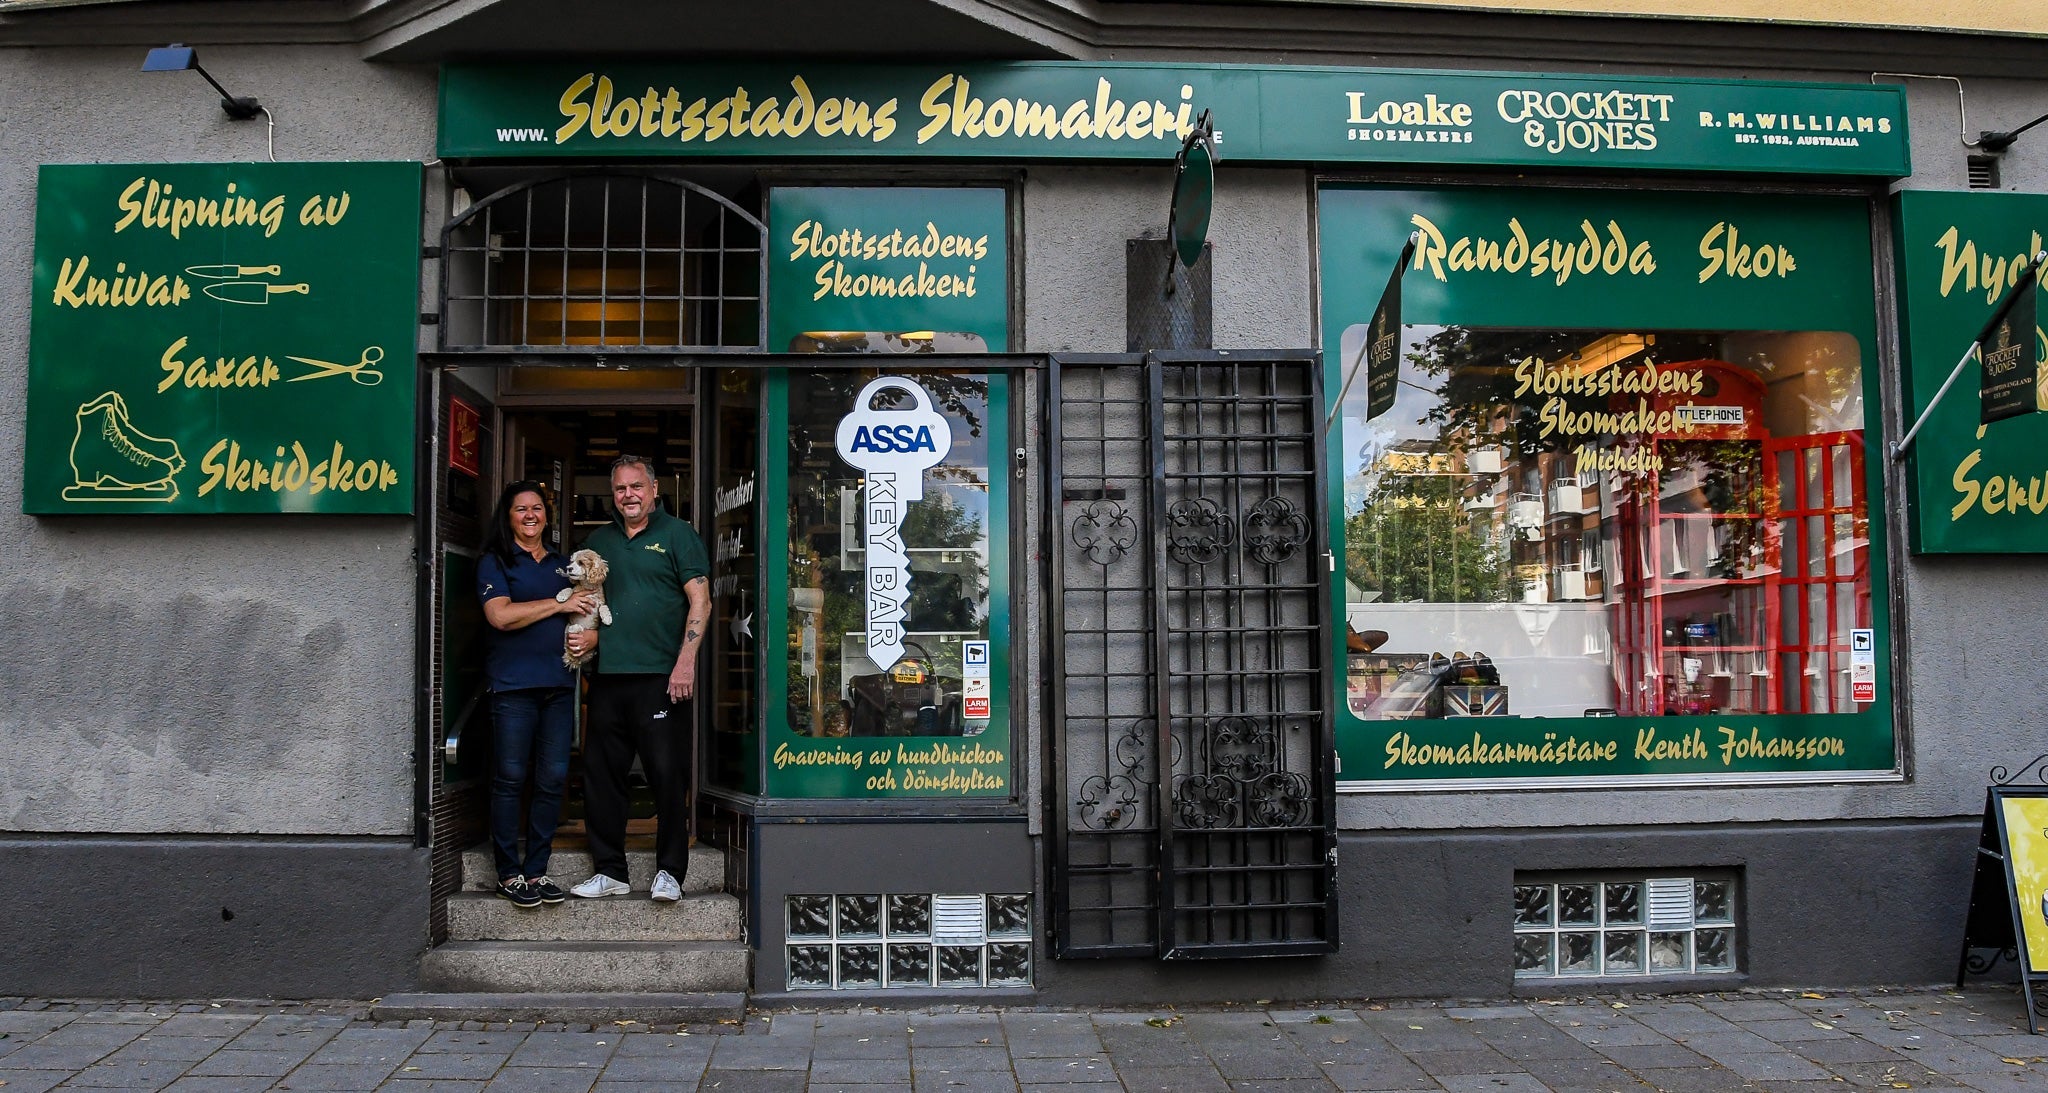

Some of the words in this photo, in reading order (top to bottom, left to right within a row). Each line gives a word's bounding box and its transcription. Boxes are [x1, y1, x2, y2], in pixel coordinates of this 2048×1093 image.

[496, 128, 549, 142] www.
[555, 73, 897, 144] Slottsstadens
[917, 73, 1195, 145] Skomakeri
[1345, 91, 1473, 127] Loake
[1497, 89, 1674, 124] CROCKETT
[1347, 128, 1473, 143] SHOEMAKERS
[1735, 133, 1759, 144] EST.
[1796, 135, 1859, 147] AUSTRALIA
[114, 176, 285, 239] Slipning
[299, 190, 350, 227] av
[790, 219, 988, 262] Slottsstadens
[1411, 214, 1657, 287] Randsydda
[1698, 221, 1797, 284] Skor
[53, 256, 191, 309] Knivar
[813, 261, 977, 302] Skomakeri
[157, 336, 281, 394] Saxar
[1514, 356, 1704, 400] Slottsstadens
[1985, 345, 2021, 367] CROCKETT
[1539, 396, 1695, 440] Skomakeri
[197, 438, 399, 498] Skridskor
[1573, 444, 1664, 475] Michelin
[868, 472, 897, 554] KEY
[869, 566, 898, 648] BAR
[773, 742, 863, 769] Gravering
[868, 749, 892, 766] av
[897, 742, 1004, 766] hundbrickor
[1384, 730, 1618, 770] Skomakarmästare
[1634, 727, 1709, 761] Kenth
[1718, 726, 1845, 766] Johansson
[866, 768, 897, 791] och
[903, 767, 1004, 794] dörrskyltar
